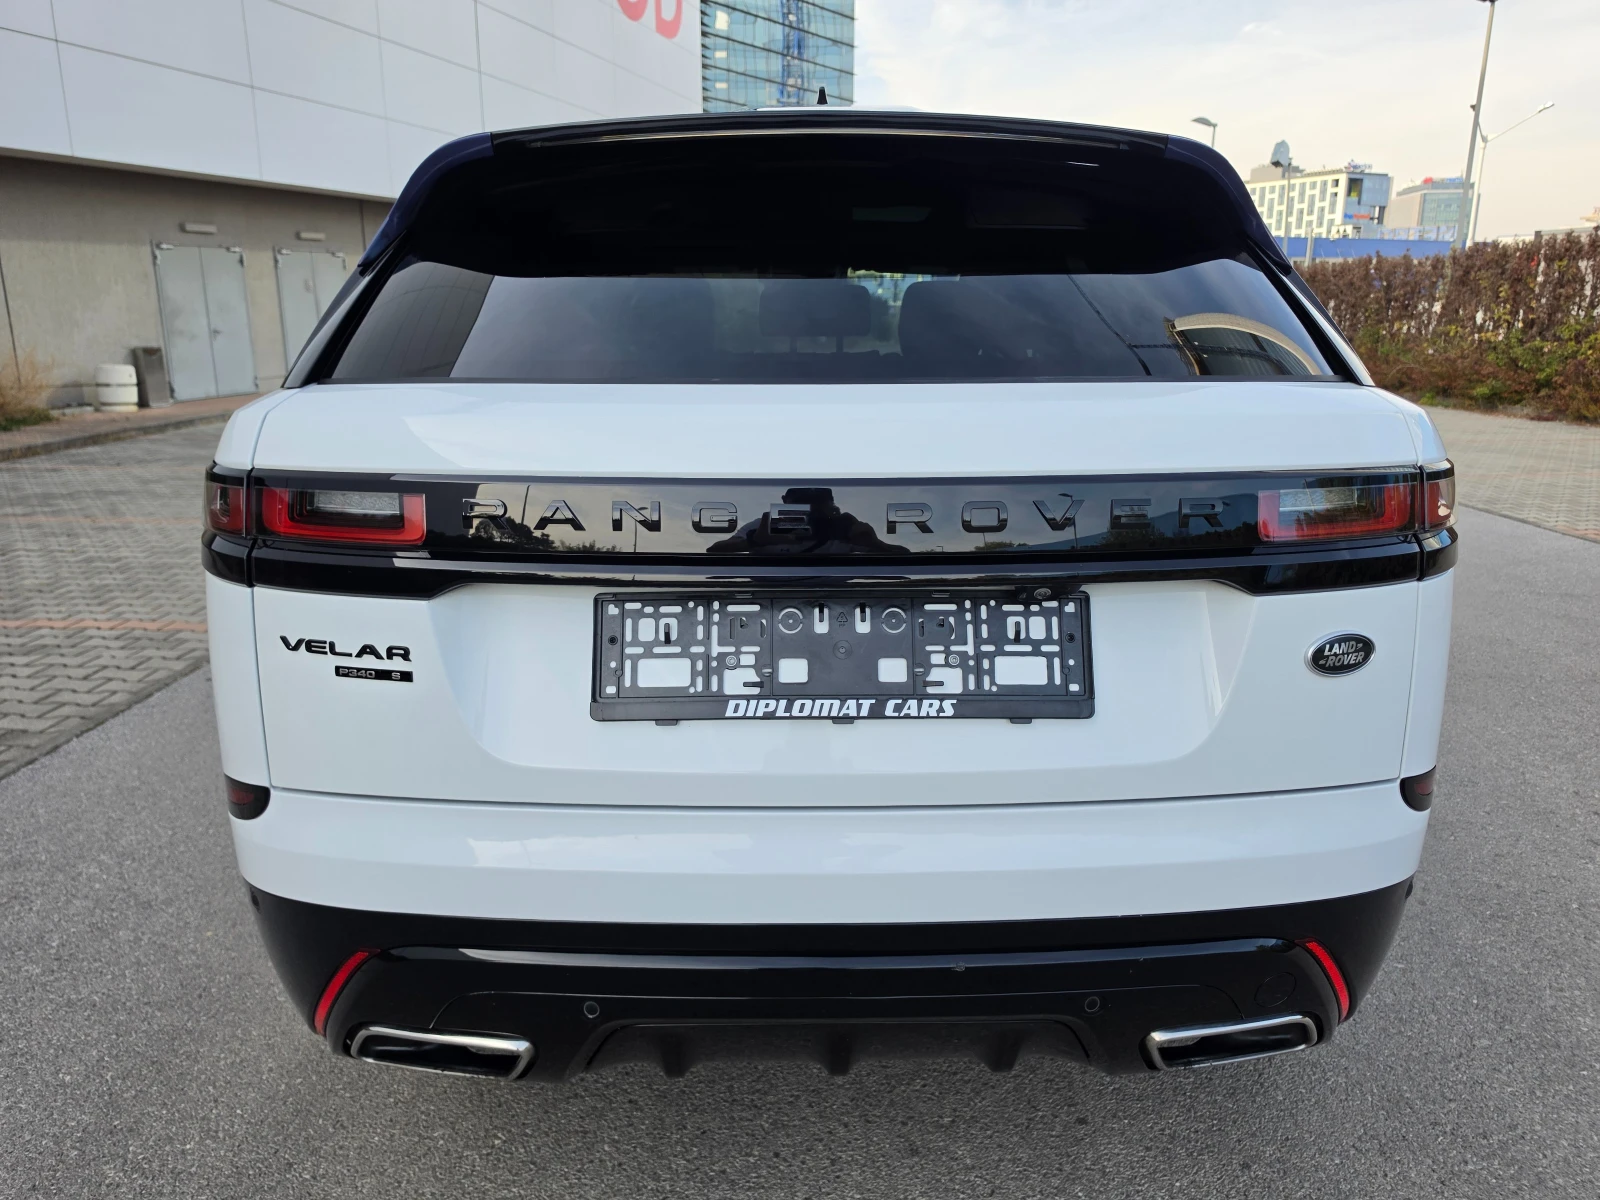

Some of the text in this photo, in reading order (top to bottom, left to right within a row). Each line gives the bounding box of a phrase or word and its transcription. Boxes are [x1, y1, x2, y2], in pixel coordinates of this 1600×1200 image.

[462, 497, 1224, 535] RANGE ROVER
[279, 635, 412, 662] VELAR
[1323, 641, 1357, 656] LAND
[1325, 651, 1365, 667] ROVER
[339, 668, 401, 681] P340 S
[724, 699, 957, 717] DIPLOMAT CARS
